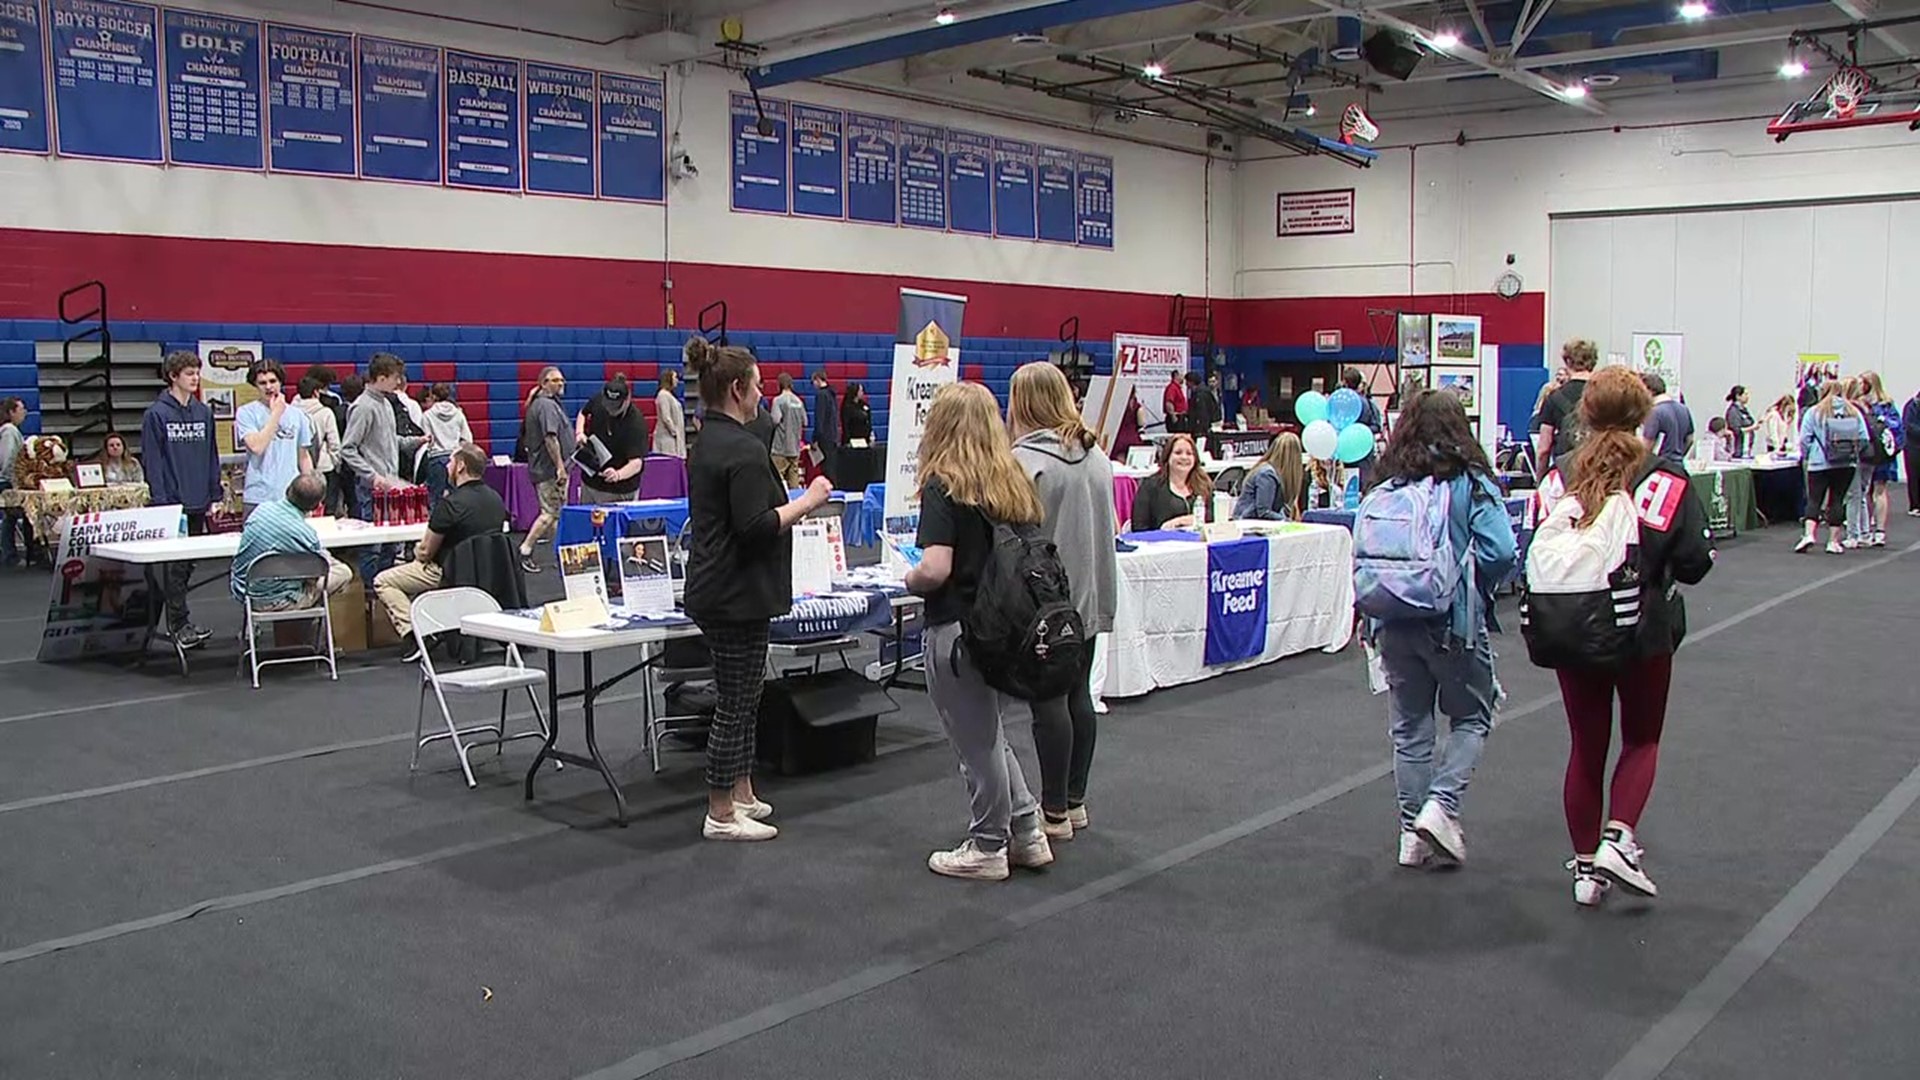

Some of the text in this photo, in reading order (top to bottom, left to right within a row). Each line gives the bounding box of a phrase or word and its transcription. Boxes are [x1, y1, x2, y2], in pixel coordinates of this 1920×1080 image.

[55, 10, 153, 40] BOYS SOCCER
[183, 17, 227, 32] DISTRICT
[75, 37, 136, 54] CHAMPIONS
[180, 33, 245, 56] GOLF
[270, 43, 350, 69] FOOTBALL
[185, 61, 241, 78] CHAMPIONS
[283, 64, 339, 79] CHAMPIONS
[376, 75, 424, 90] CHAMPIONS
[448, 68, 517, 94] BASEBALL
[528, 80, 593, 103] WRESTLING
[459, 97, 508, 112] CHAMPIONS
[600, 90, 662, 113] WRESTLING
[538, 106, 583, 121] CHAMPIONS
[610, 116, 653, 130] CHAMPIONS
[794, 115, 840, 137] BASKETBALL
[1140, 346, 1183, 364] ZARTMAN
[166, 422, 206, 431] OUTER
[167, 430, 206, 438] BANKS
[68, 527, 166, 547] COLLEGE DEGREE
[70, 520, 137, 538] EARN YOUR
[67, 547, 84, 558] AT
[1222, 588, 1258, 616] Feed
[798, 620, 839, 633] COLLEGE
